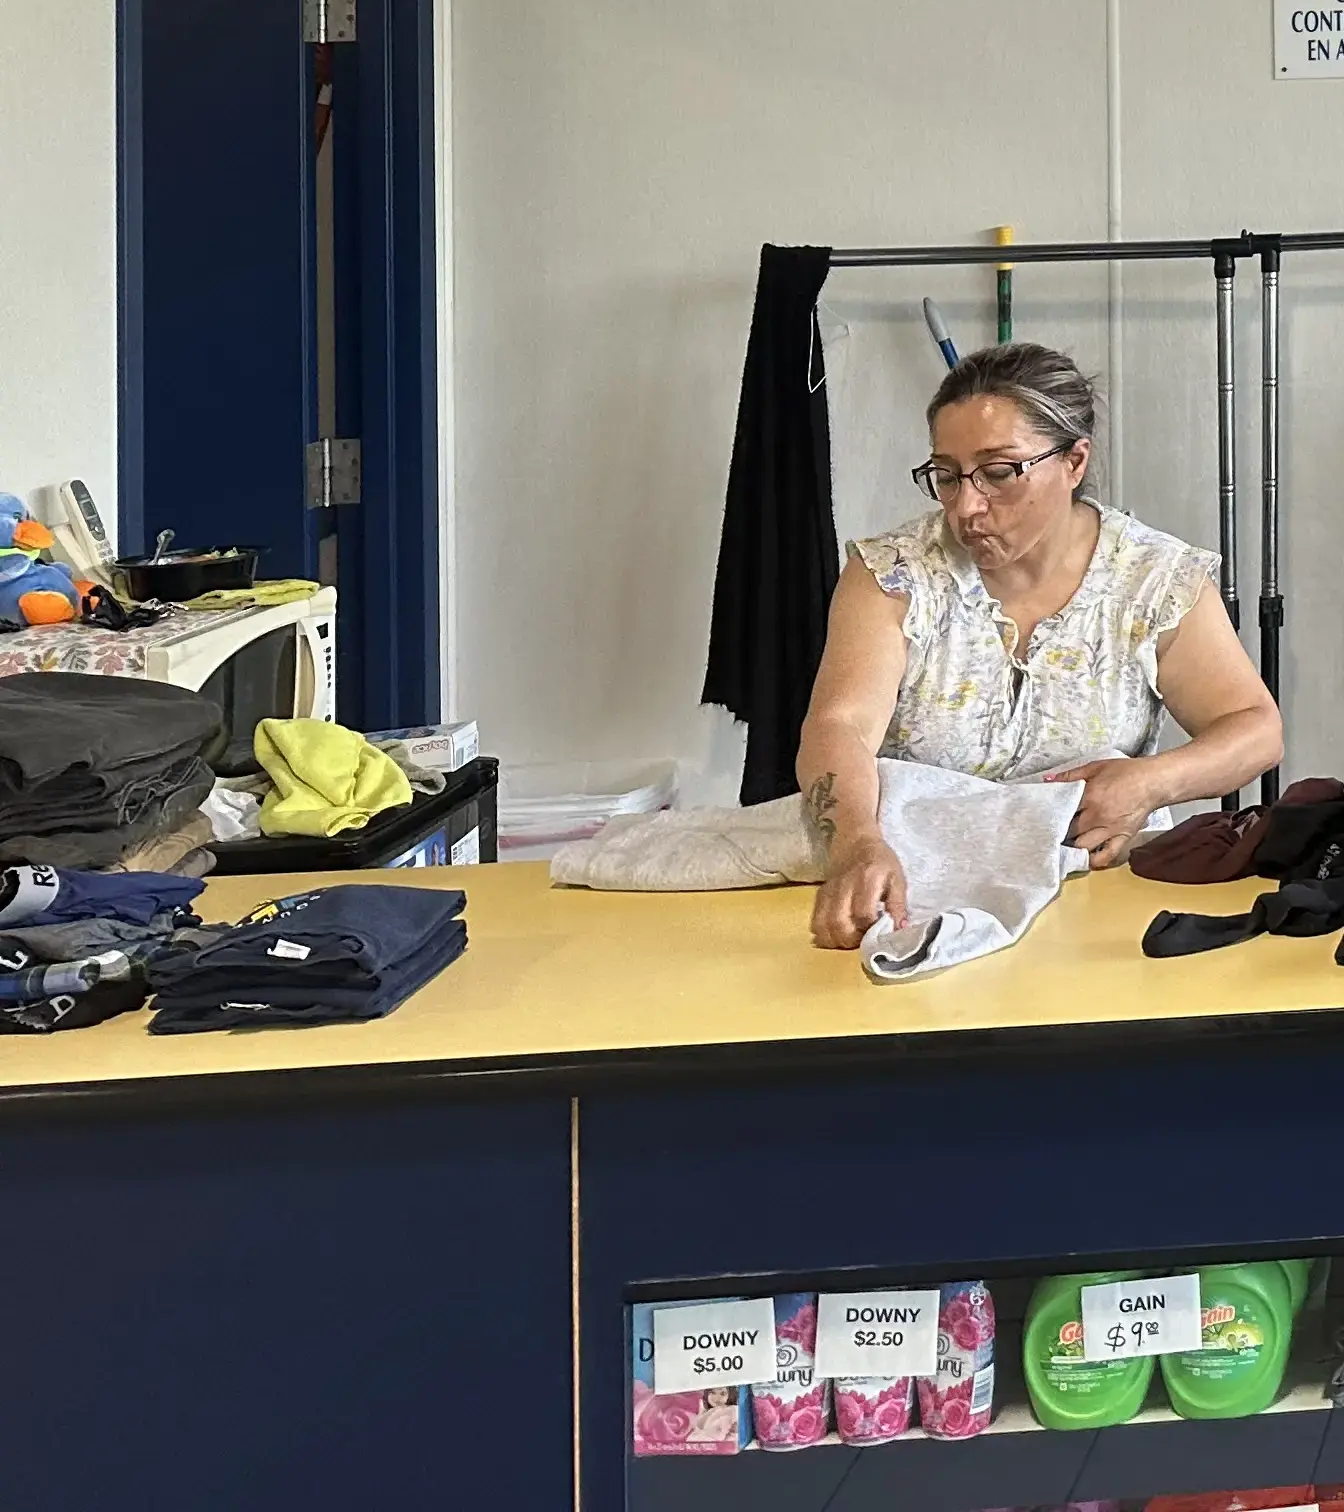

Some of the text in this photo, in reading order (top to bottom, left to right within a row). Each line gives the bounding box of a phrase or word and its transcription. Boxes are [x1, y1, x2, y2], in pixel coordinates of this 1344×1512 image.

[1308, 39, 1330, 60] EN
[1120, 1294, 1165, 1312] GAIN
[846, 1308, 921, 1322] DOWNY
[683, 1330, 759, 1350] DOWNY
[854, 1331, 903, 1347] $2.50
[694, 1356, 743, 1374] $5.00
